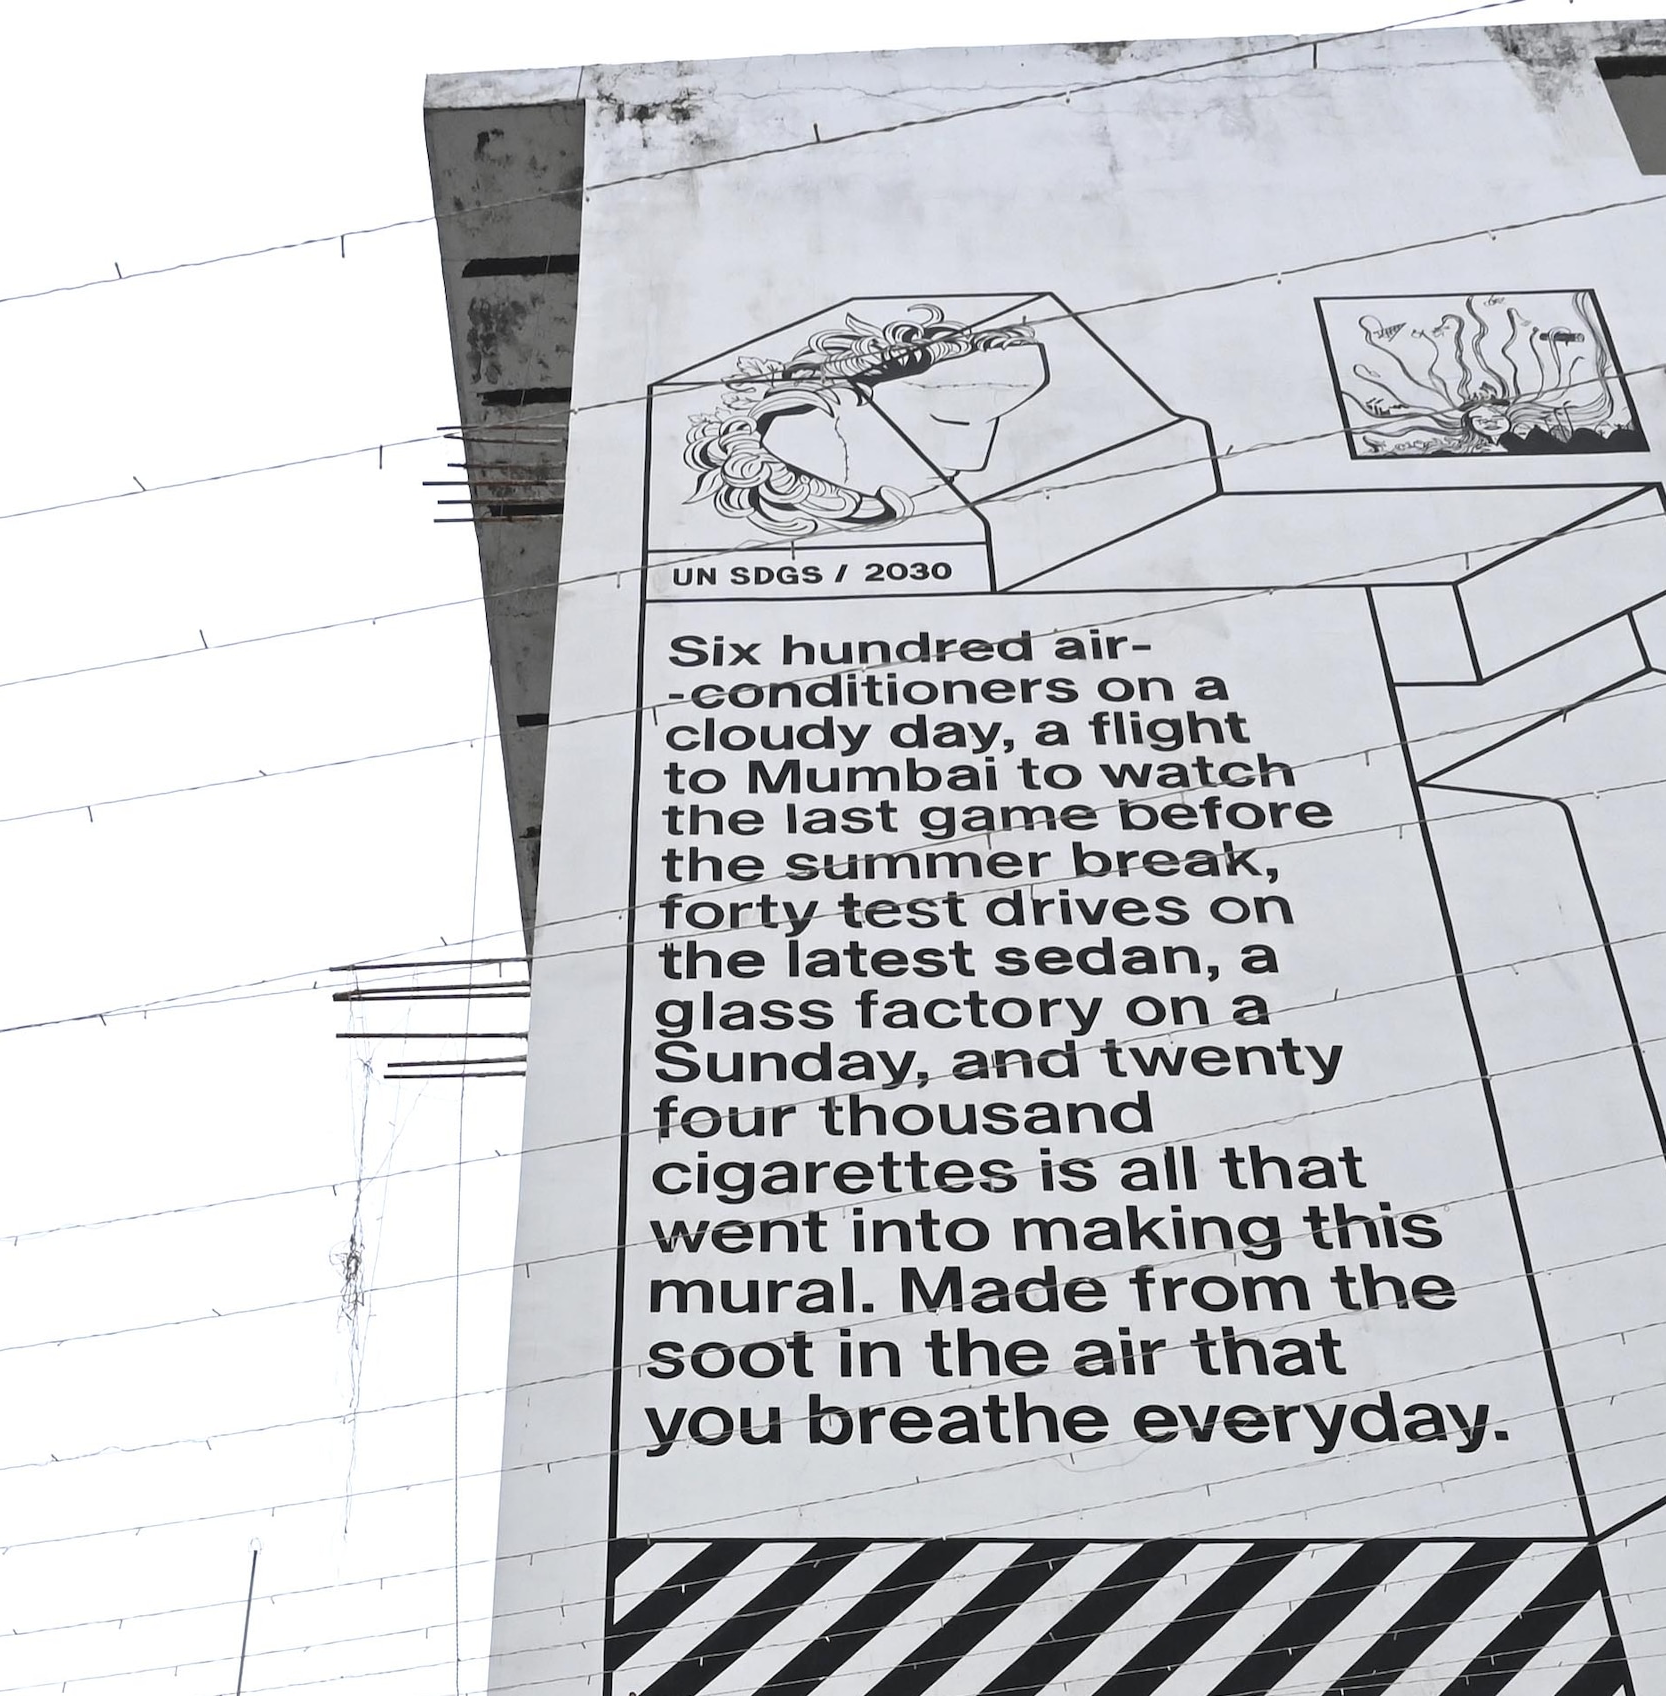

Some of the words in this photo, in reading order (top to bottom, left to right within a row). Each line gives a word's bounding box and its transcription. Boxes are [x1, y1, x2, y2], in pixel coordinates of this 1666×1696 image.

[673, 567, 716, 586] UN
[730, 566, 823, 585] SDGS
[835, 564, 848, 583] /
[865, 562, 952, 582] 2030
[669, 635, 761, 667] Six
[783, 630, 1033, 665] hundred
[1055, 629, 1151, 660] air-
[1097, 677, 1174, 702] on
[1194, 676, 1229, 701] a
[666, 716, 872, 757] cloudy
[890, 714, 1014, 755] day,
[1035, 720, 1070, 746] a
[1088, 710, 1251, 752] flight
[663, 762, 726, 795] to
[748, 756, 998, 794] Mumbai
[1017, 758, 1082, 790] to
[1099, 753, 1295, 789] watch
[661, 804, 764, 836] the
[786, 799, 898, 834] last
[919, 804, 1099, 840] game
[1119, 796, 1333, 831] before
[661, 846, 765, 883] the
[786, 851, 1051, 881] summer
[1072, 840, 1278, 884] break,
[659, 893, 819, 938] forty
[837, 891, 967, 929] test
[986, 888, 1190, 927] drives
[1210, 895, 1294, 924] on
[658, 940, 765, 980] the
[788, 939, 976, 978] latest
[995, 937, 1219, 982] sedan,
[1241, 944, 1279, 974] a
[655, 990, 834, 1038] glass
[855, 989, 1103, 1037] factory
[1126, 995, 1210, 1027] on
[1232, 994, 1270, 1026] a
[654, 1040, 929, 1090] Sunday,
[952, 1039, 1080, 1081] and
[1099, 1037, 1343, 1085] twenty
[653, 1095, 797, 1140] four
[818, 1090, 1154, 1136] thousand
[652, 1151, 1018, 1205] cigarettes
[1040, 1147, 1097, 1193] is
[1120, 1145, 1197, 1192] all
[1219, 1145, 1367, 1190] that
[649, 1210, 828, 1254] went
[853, 1207, 990, 1252] into
[1013, 1204, 1282, 1261] making
[1302, 1201, 1443, 1250] this
[650, 1267, 874, 1314] mural.
[901, 1265, 1108, 1314] Made
[1128, 1266, 1311, 1312] from
[1330, 1263, 1457, 1311] the
[647, 1331, 814, 1380] soot
[839, 1328, 901, 1378] in
[924, 1327, 1049, 1377] the
[1073, 1326, 1166, 1377] air
[1190, 1326, 1347, 1377] that
[644, 1406, 782, 1458] you
[809, 1391, 1109, 1446] breathe
[1133, 1390, 1509, 1454] everyday.
